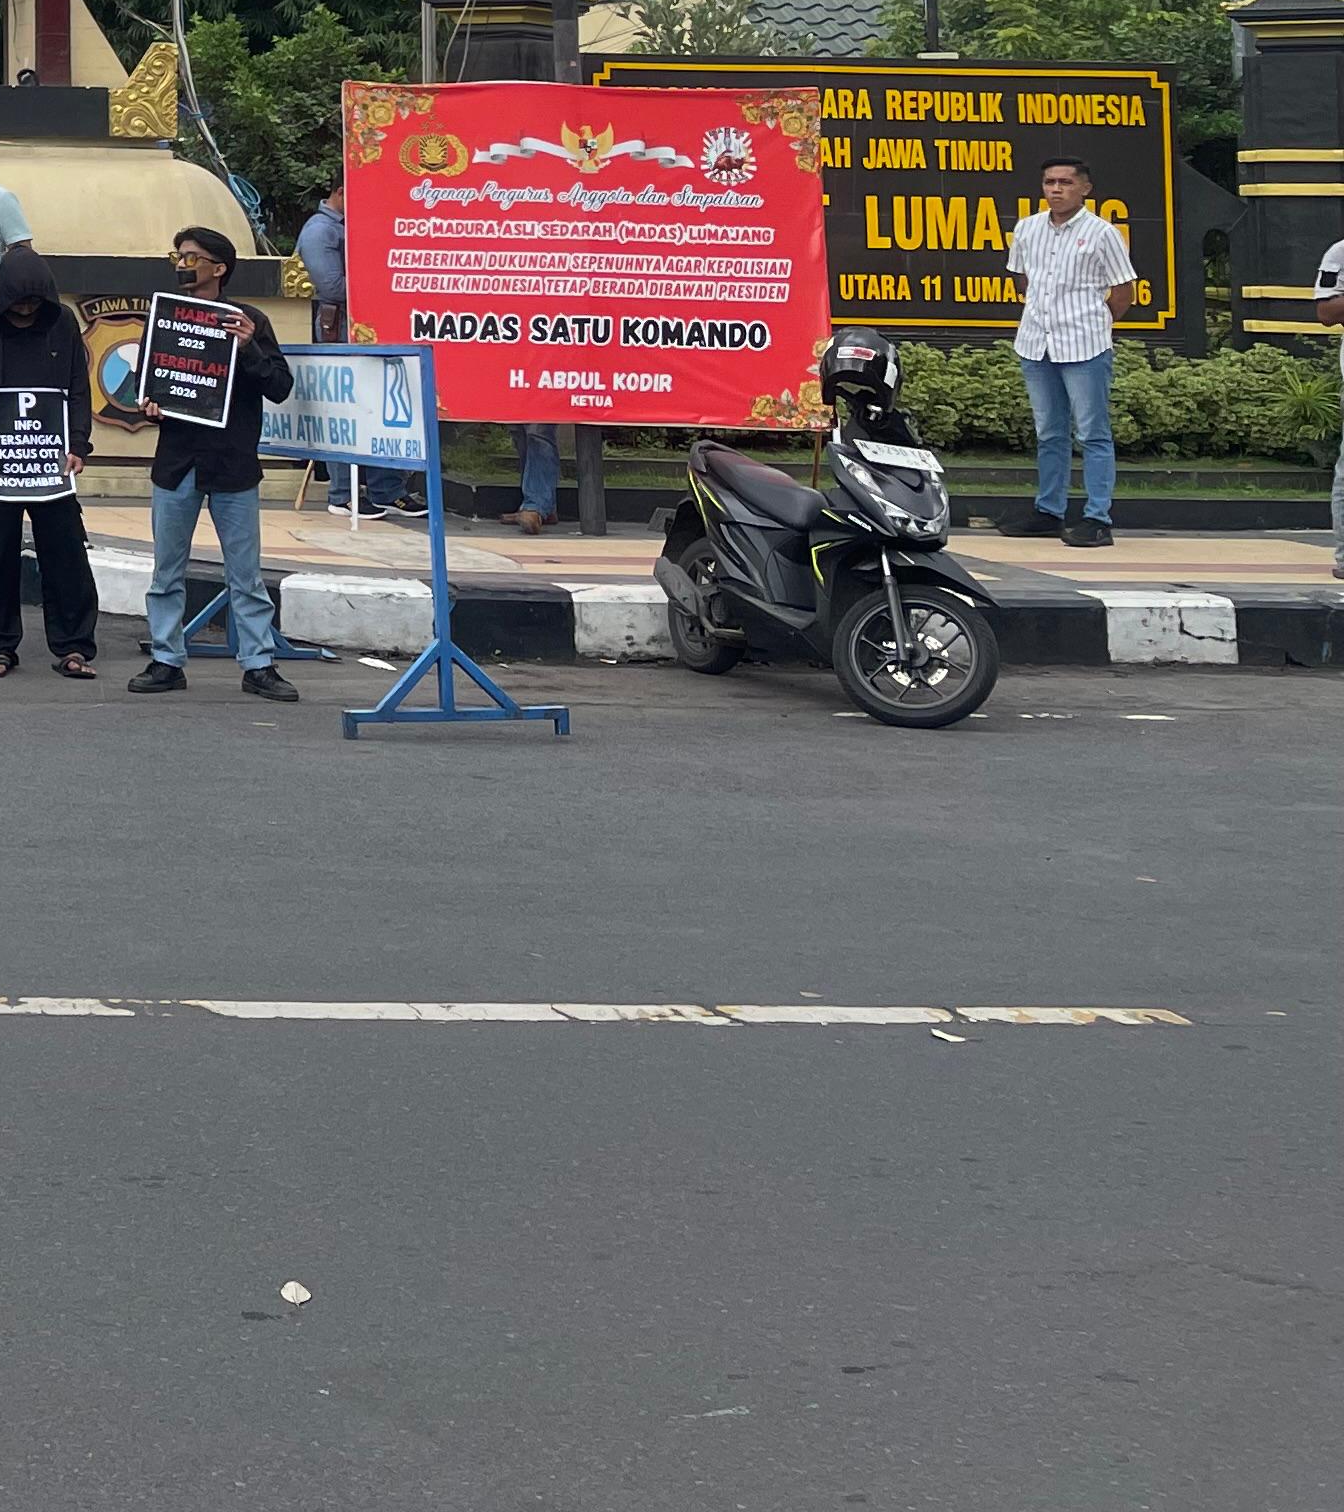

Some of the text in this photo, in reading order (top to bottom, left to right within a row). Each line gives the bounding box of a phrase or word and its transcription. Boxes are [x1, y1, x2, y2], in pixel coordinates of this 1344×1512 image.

[886, 89, 1146, 126] REPUBLIK INDONESIA
[862, 138, 1012, 171] JAWA TIMUR
[410, 181, 477, 207] Segenap
[560, 182, 632, 211] Anggota
[637, 186, 669, 206] dan
[671, 185, 762, 210] Simpatisan
[396, 221, 771, 243] DPC MADURA ASLI SEDARAH (MADAS) LUMAJANG
[391, 252, 789, 275] MEMBERIKAN DUKUNGAN SEPENUHNYA AGAR KEPOLISIAN
[395, 275, 787, 299] REPUBLIK INDONESIA TETAP BERADA DIBAWAH PRESIDEN
[840, 274, 942, 301] UTARA 11
[92, 298, 128, 314] JAWA
[175, 306, 218, 325] HABIS
[157, 319, 227, 340] 03 NOVEMBER
[413, 313, 768, 348] MADAS SATU KOMANDO
[178, 338, 205, 350] 2025
[153, 352, 229, 377] TERBITLAH
[154, 368, 217, 387] 07 FEBRUARI
[295, 365, 356, 403] ARKIR
[509, 370, 672, 392] H. ABDUL KODIR
[170, 386, 197, 398] 2026
[571, 395, 613, 408] KETUA
[18, 393, 36, 417] P
[14, 420, 41, 431] INFO
[297, 415, 356, 446] ATM BRI
[39, 449, 59, 459] OTT
[371, 438, 421, 458] BANK BRI
[3, 463, 59, 473] SOLAR 03
[0, 476, 63, 487] NOVEMBER
